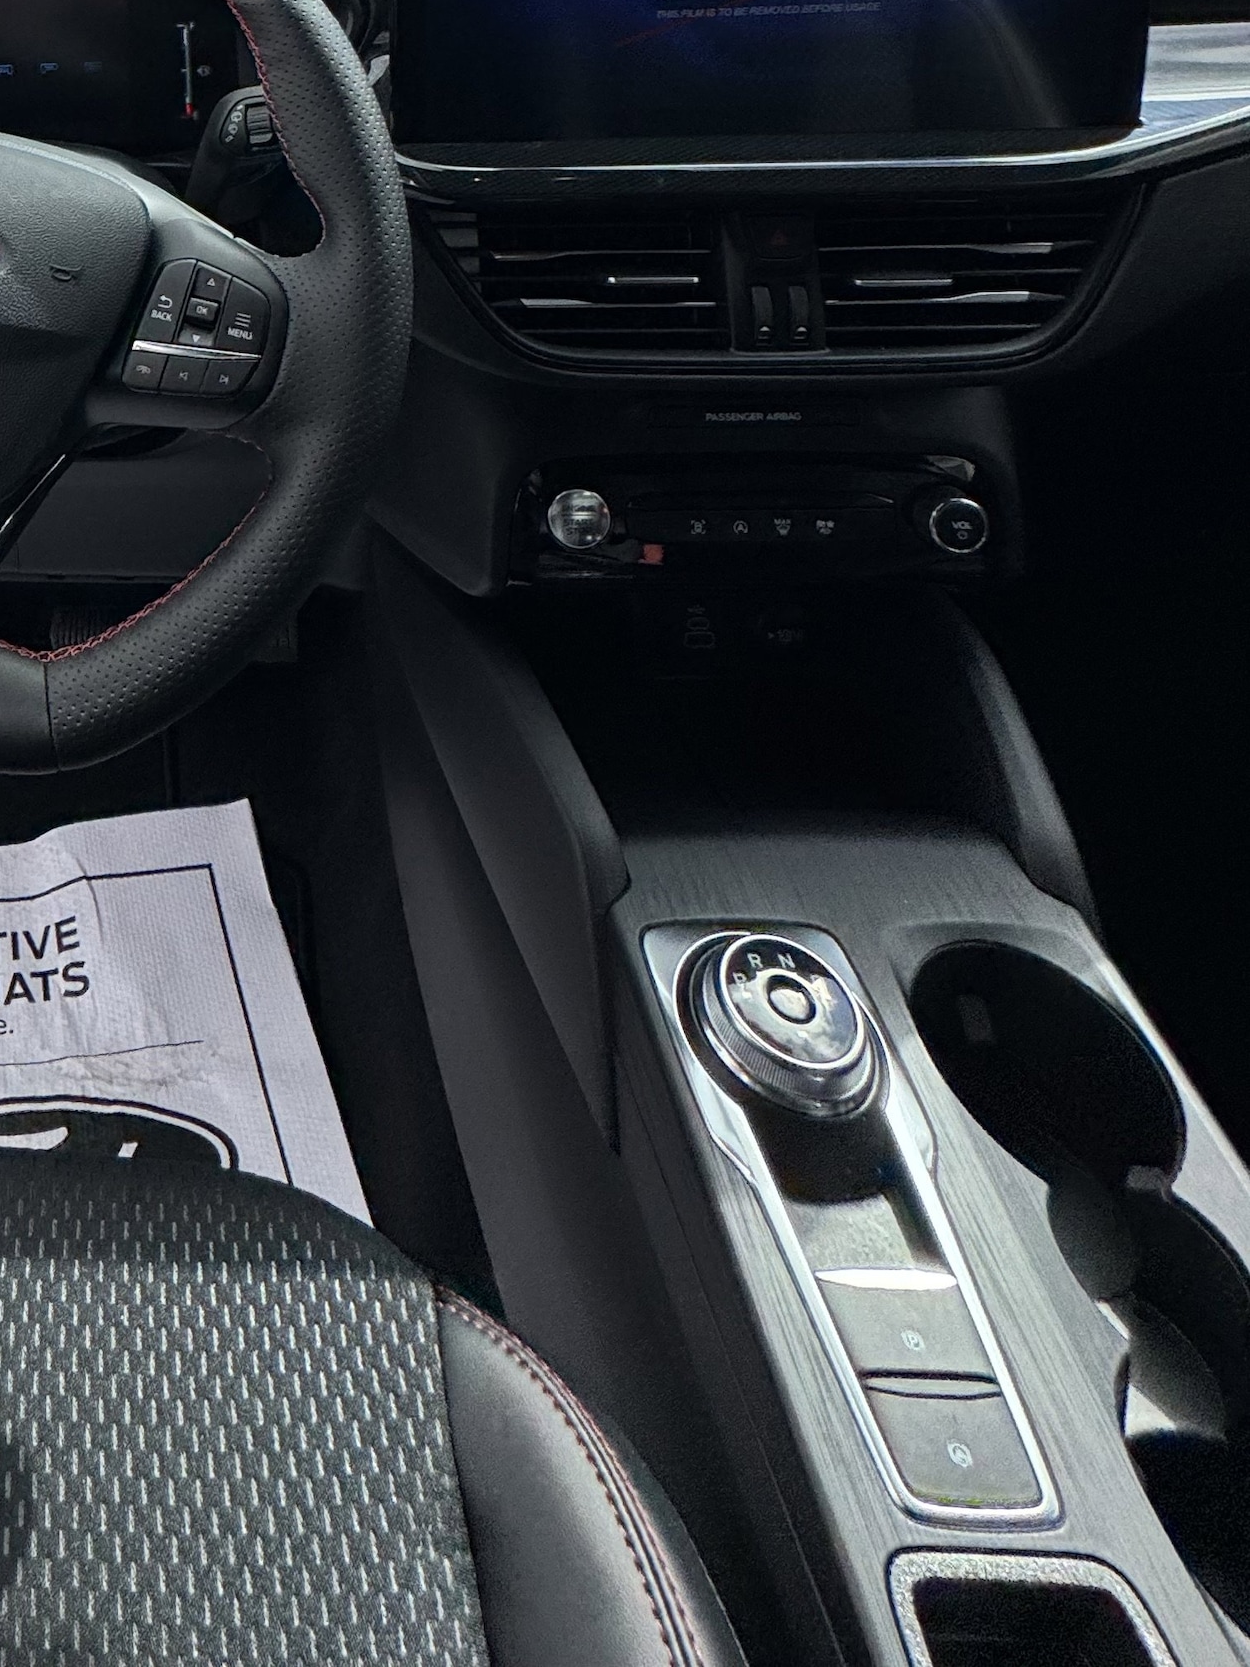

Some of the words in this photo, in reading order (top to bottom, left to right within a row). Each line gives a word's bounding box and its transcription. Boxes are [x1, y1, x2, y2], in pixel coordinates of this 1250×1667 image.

[656, 9, 680, 19] THIS
[706, 8, 717, 17] IS
[718, 7, 732, 16] TO
[733, 7, 750, 16] BE
[750, 5, 800, 15] REMOVED
[801, 3, 844, 14] BEFORE
[844, 2, 881, 13] USAGE
[150, 309, 172, 322] BACK
[195, 305, 209, 315] OK
[227, 326, 253, 341] MENU
[705, 412, 764, 422] PASSENGER
[766, 412, 802, 421] AIRBAG
[951, 520, 973, 530] VOL
[747, 953, 763, 969] R
[777, 953, 795, 969] N
